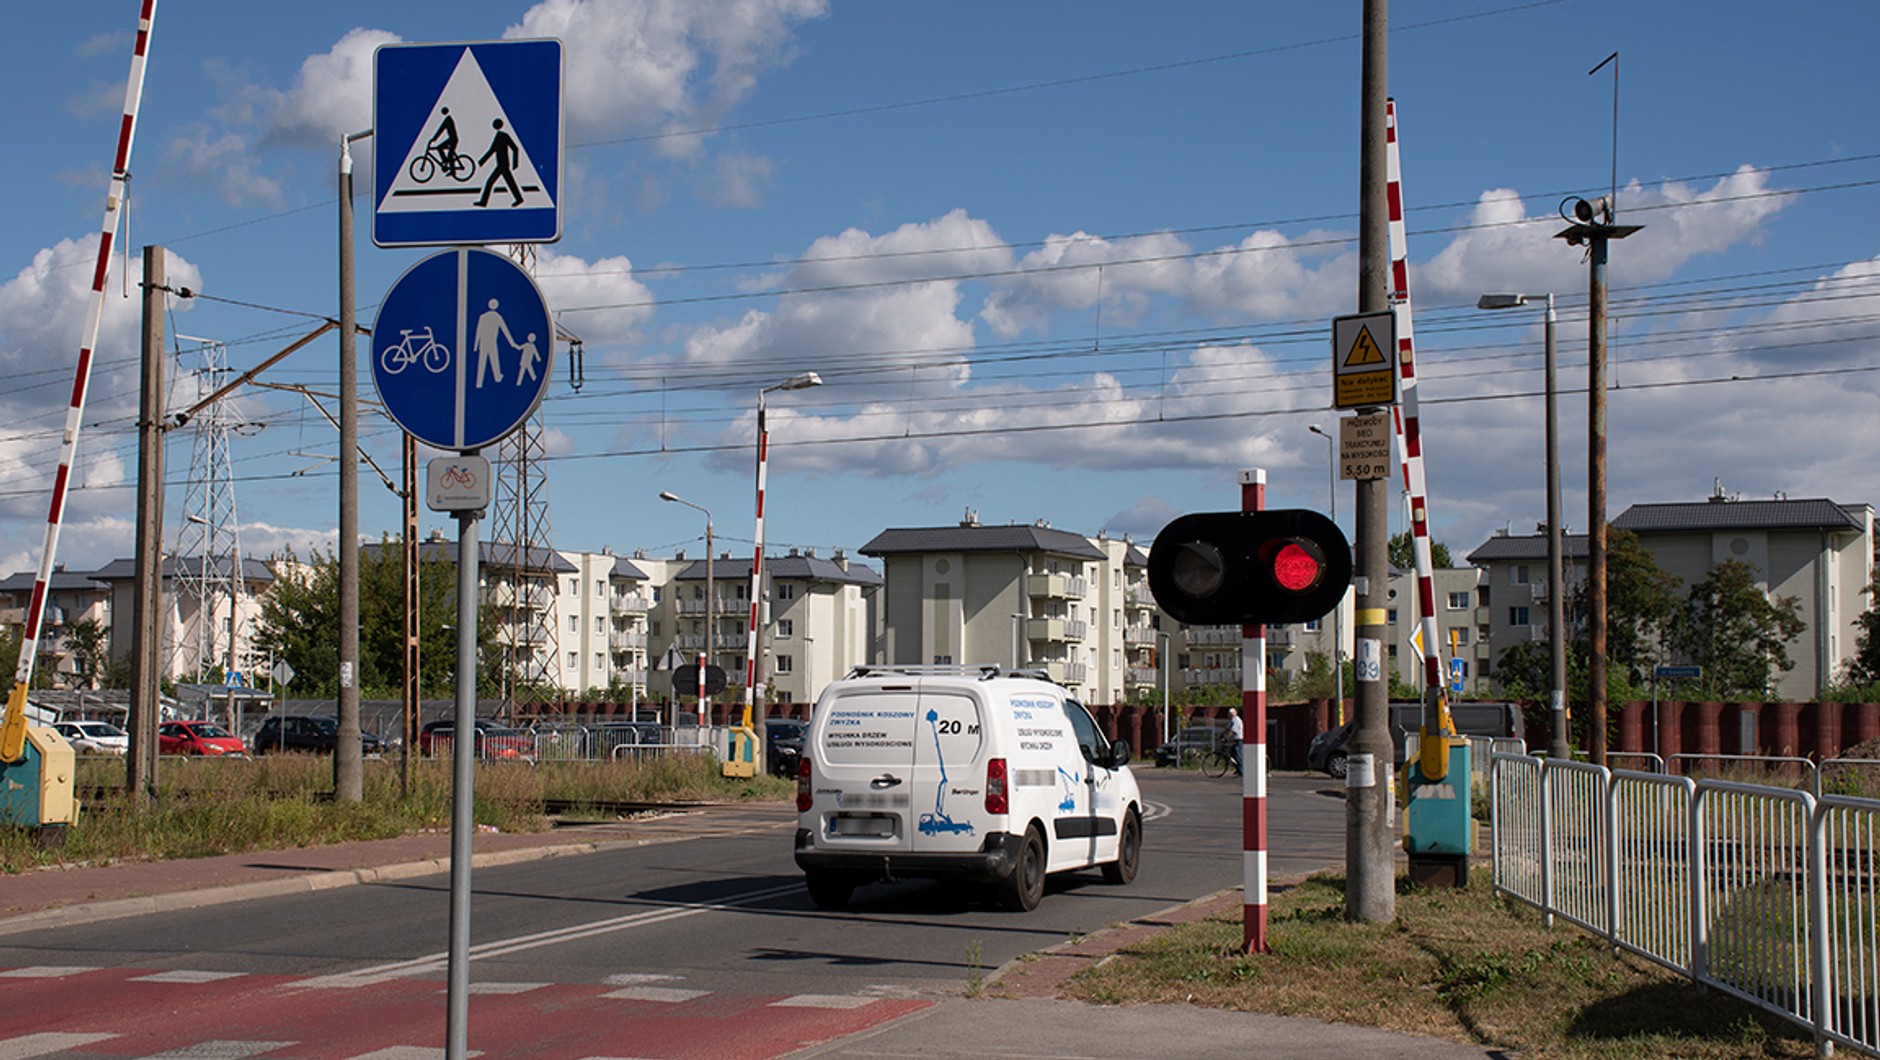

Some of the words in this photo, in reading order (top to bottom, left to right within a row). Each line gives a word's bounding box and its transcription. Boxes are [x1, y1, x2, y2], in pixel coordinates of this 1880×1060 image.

[1374, 464, 1385, 474] m
[1244, 471, 1250, 481] 1
[1364, 642, 1370, 658] 1
[938, 720, 962, 735] 20
